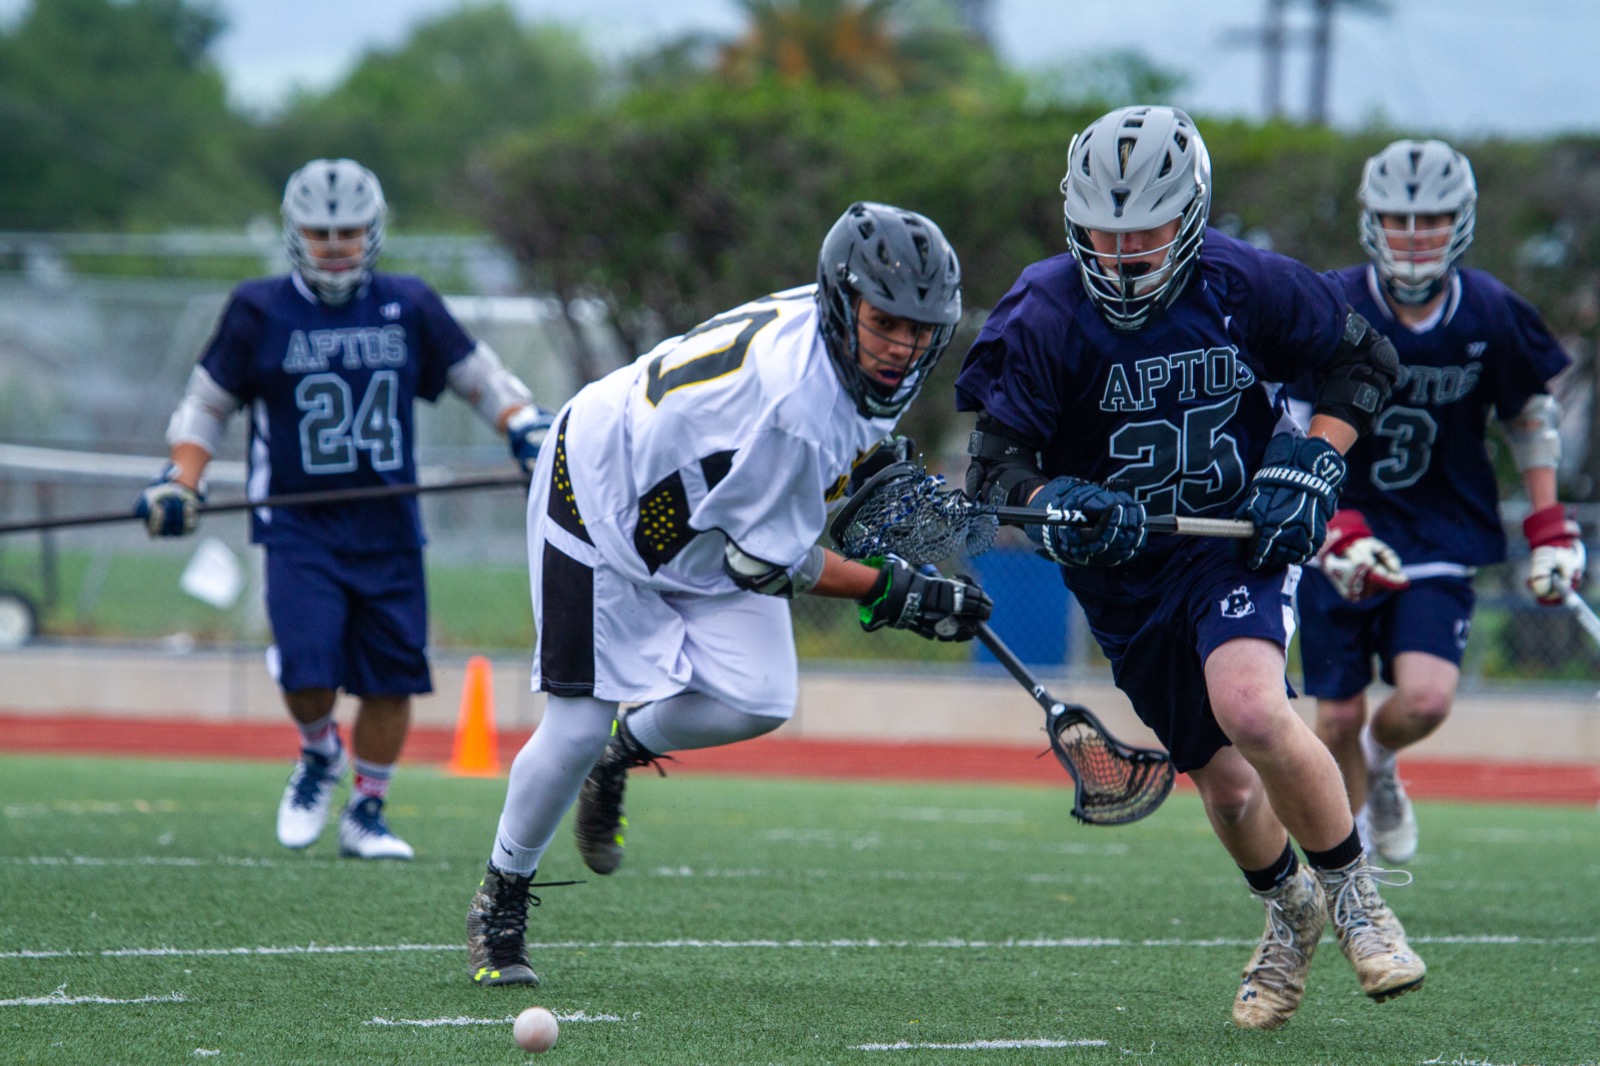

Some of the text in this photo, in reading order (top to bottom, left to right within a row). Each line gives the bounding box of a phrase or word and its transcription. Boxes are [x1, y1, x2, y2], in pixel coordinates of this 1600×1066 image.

[282, 325, 408, 374] APTOS
[1099, 344, 1255, 413] APTOS
[1391, 361, 1483, 406] PTOS
[296, 370, 404, 475] 24
[1107, 392, 1246, 518] 25
[1370, 405, 1438, 492] 3
